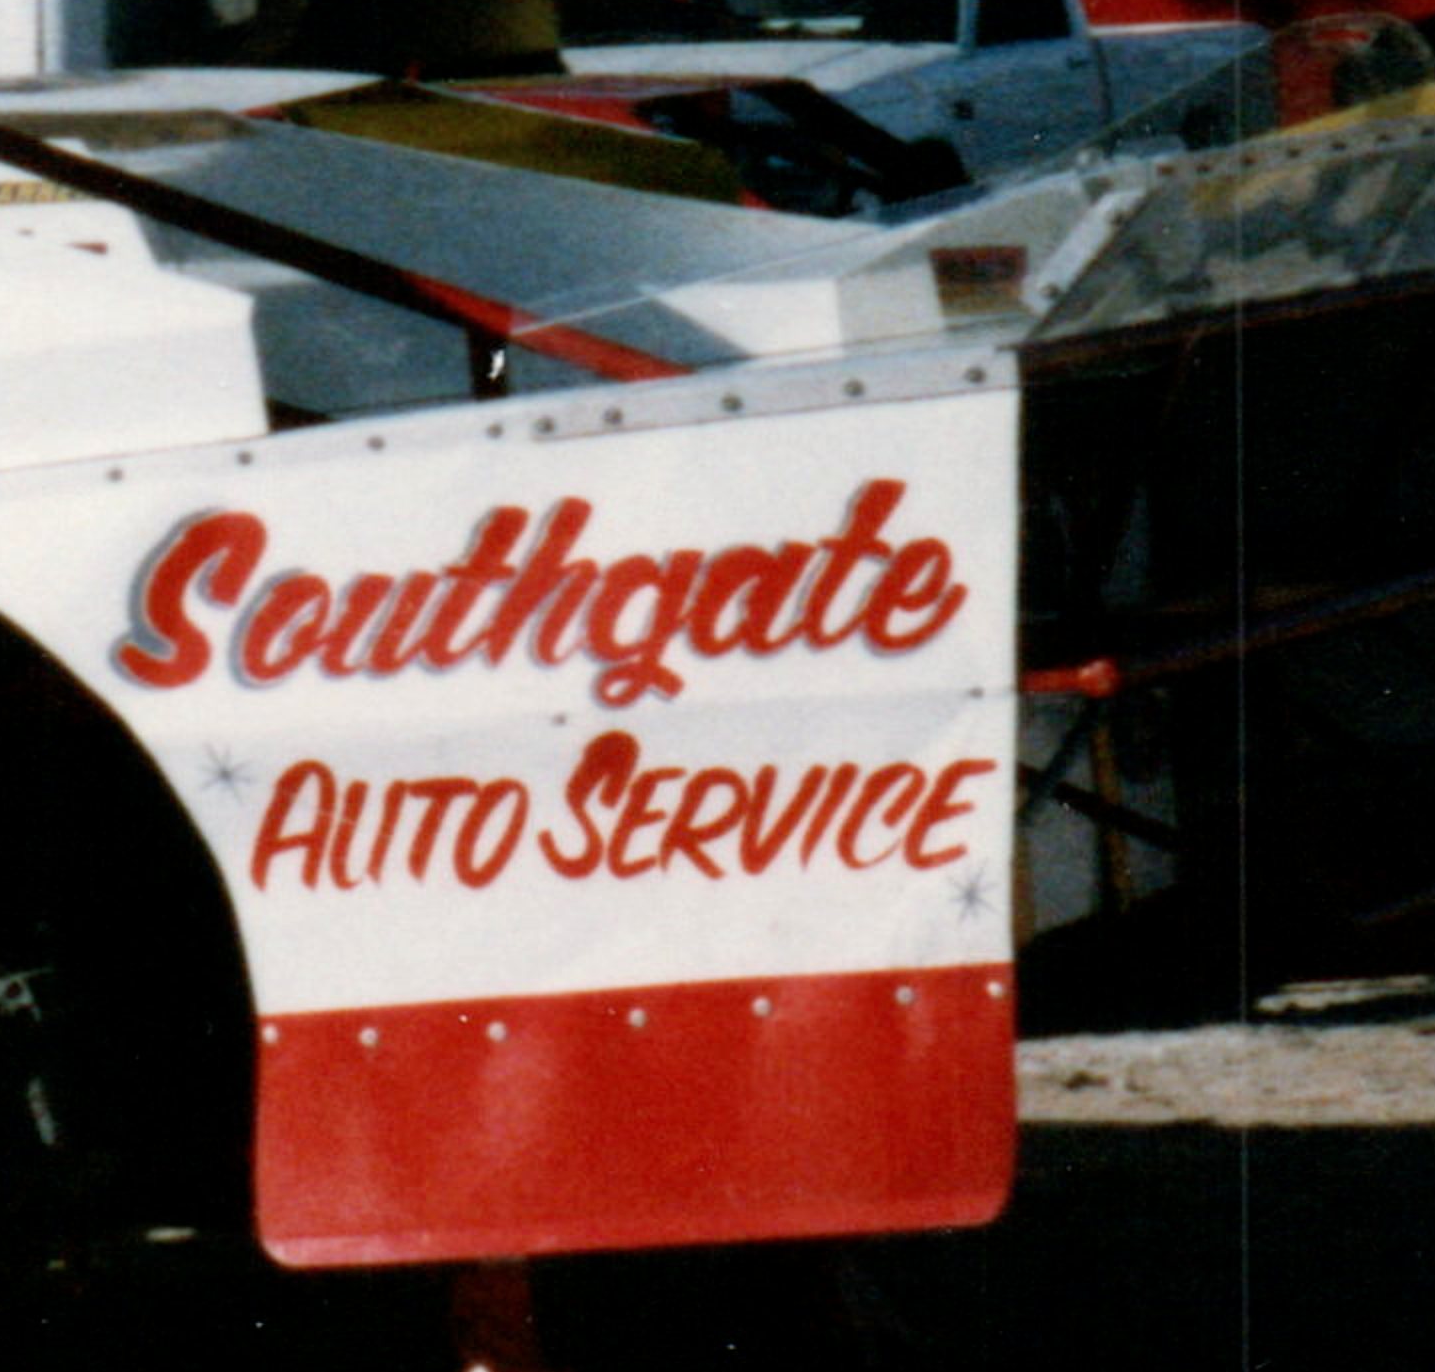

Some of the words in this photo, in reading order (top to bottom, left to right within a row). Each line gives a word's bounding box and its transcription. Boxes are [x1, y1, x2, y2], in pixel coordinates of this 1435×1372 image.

[109, 477, 969, 708] Southgate
[249, 758, 529, 893] AUTO
[537, 729, 998, 881] SERVICE
